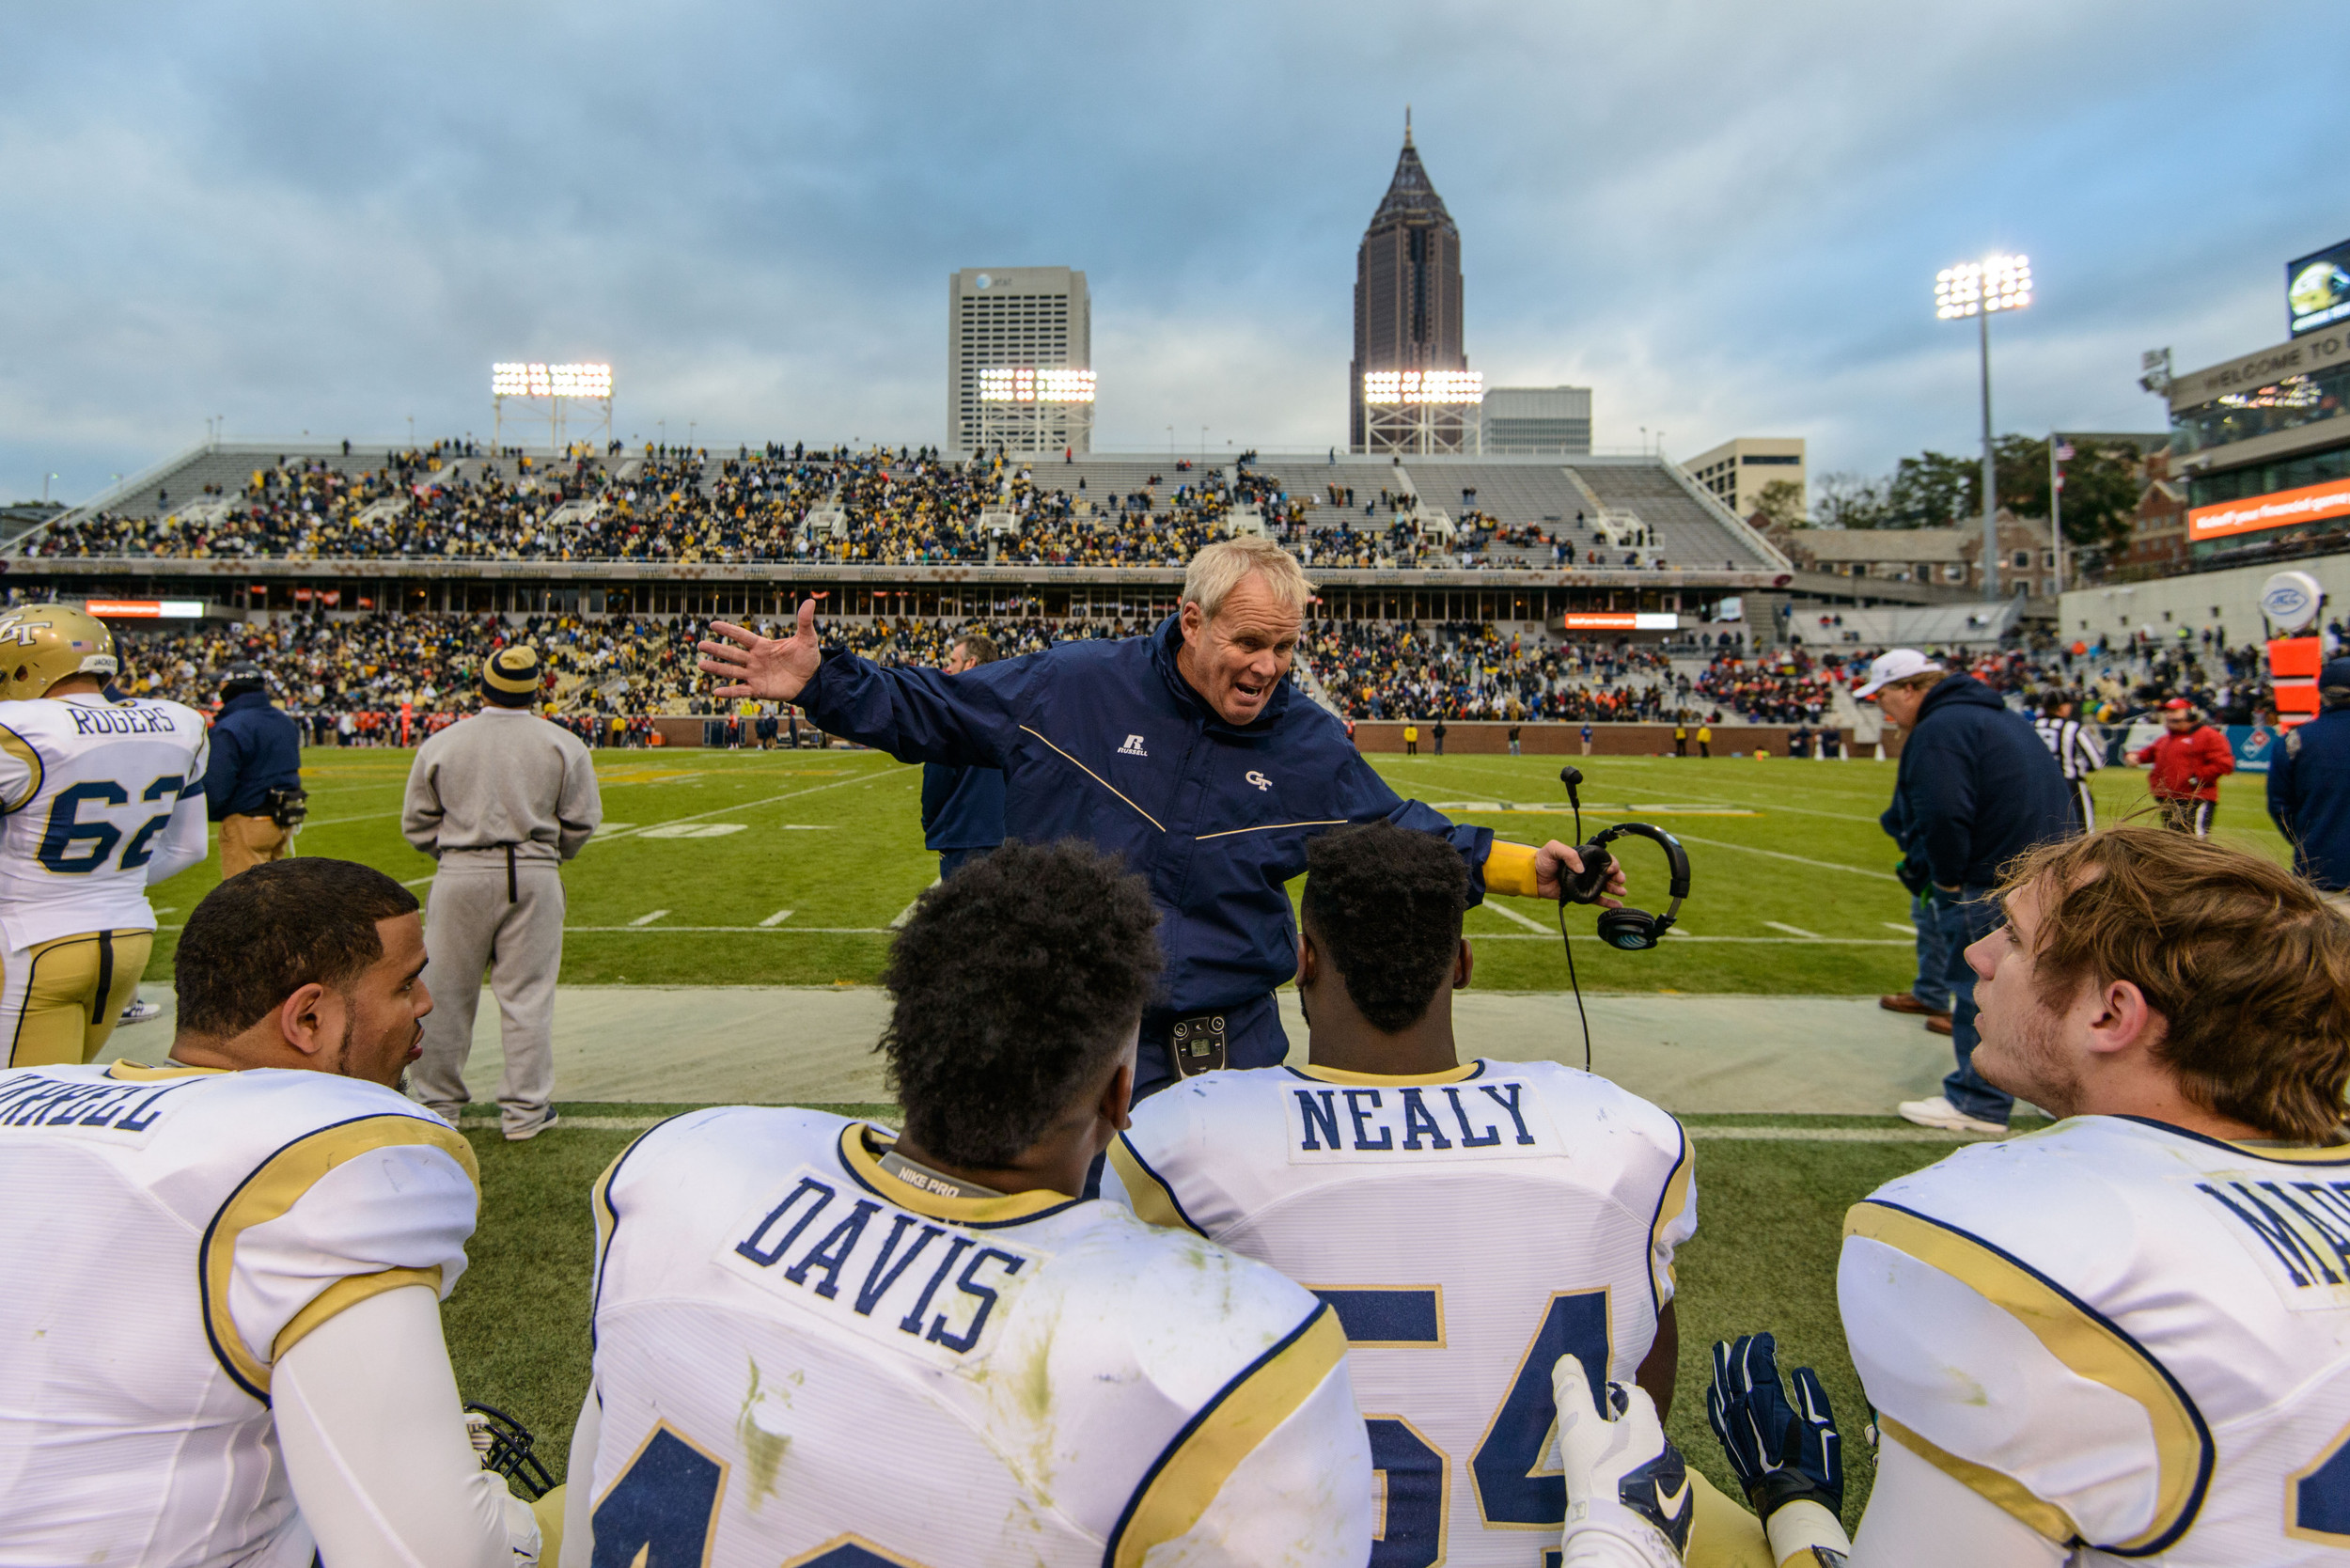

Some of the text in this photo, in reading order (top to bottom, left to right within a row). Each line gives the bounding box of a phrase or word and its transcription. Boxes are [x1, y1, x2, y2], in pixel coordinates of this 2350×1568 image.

[2203, 349, 2301, 389] WELCOME
[2311, 337, 2341, 359] TO
[67, 707, 176, 735] ROGERS
[1117, 746, 1149, 757] RUSSELL
[1245, 770, 1273, 792] GT
[32, 773, 185, 875] 62
[1293, 1083, 1536, 1151] NEALY
[898, 1167, 960, 1199] NIKE PRO
[735, 1176, 1026, 1354] DAVIS
